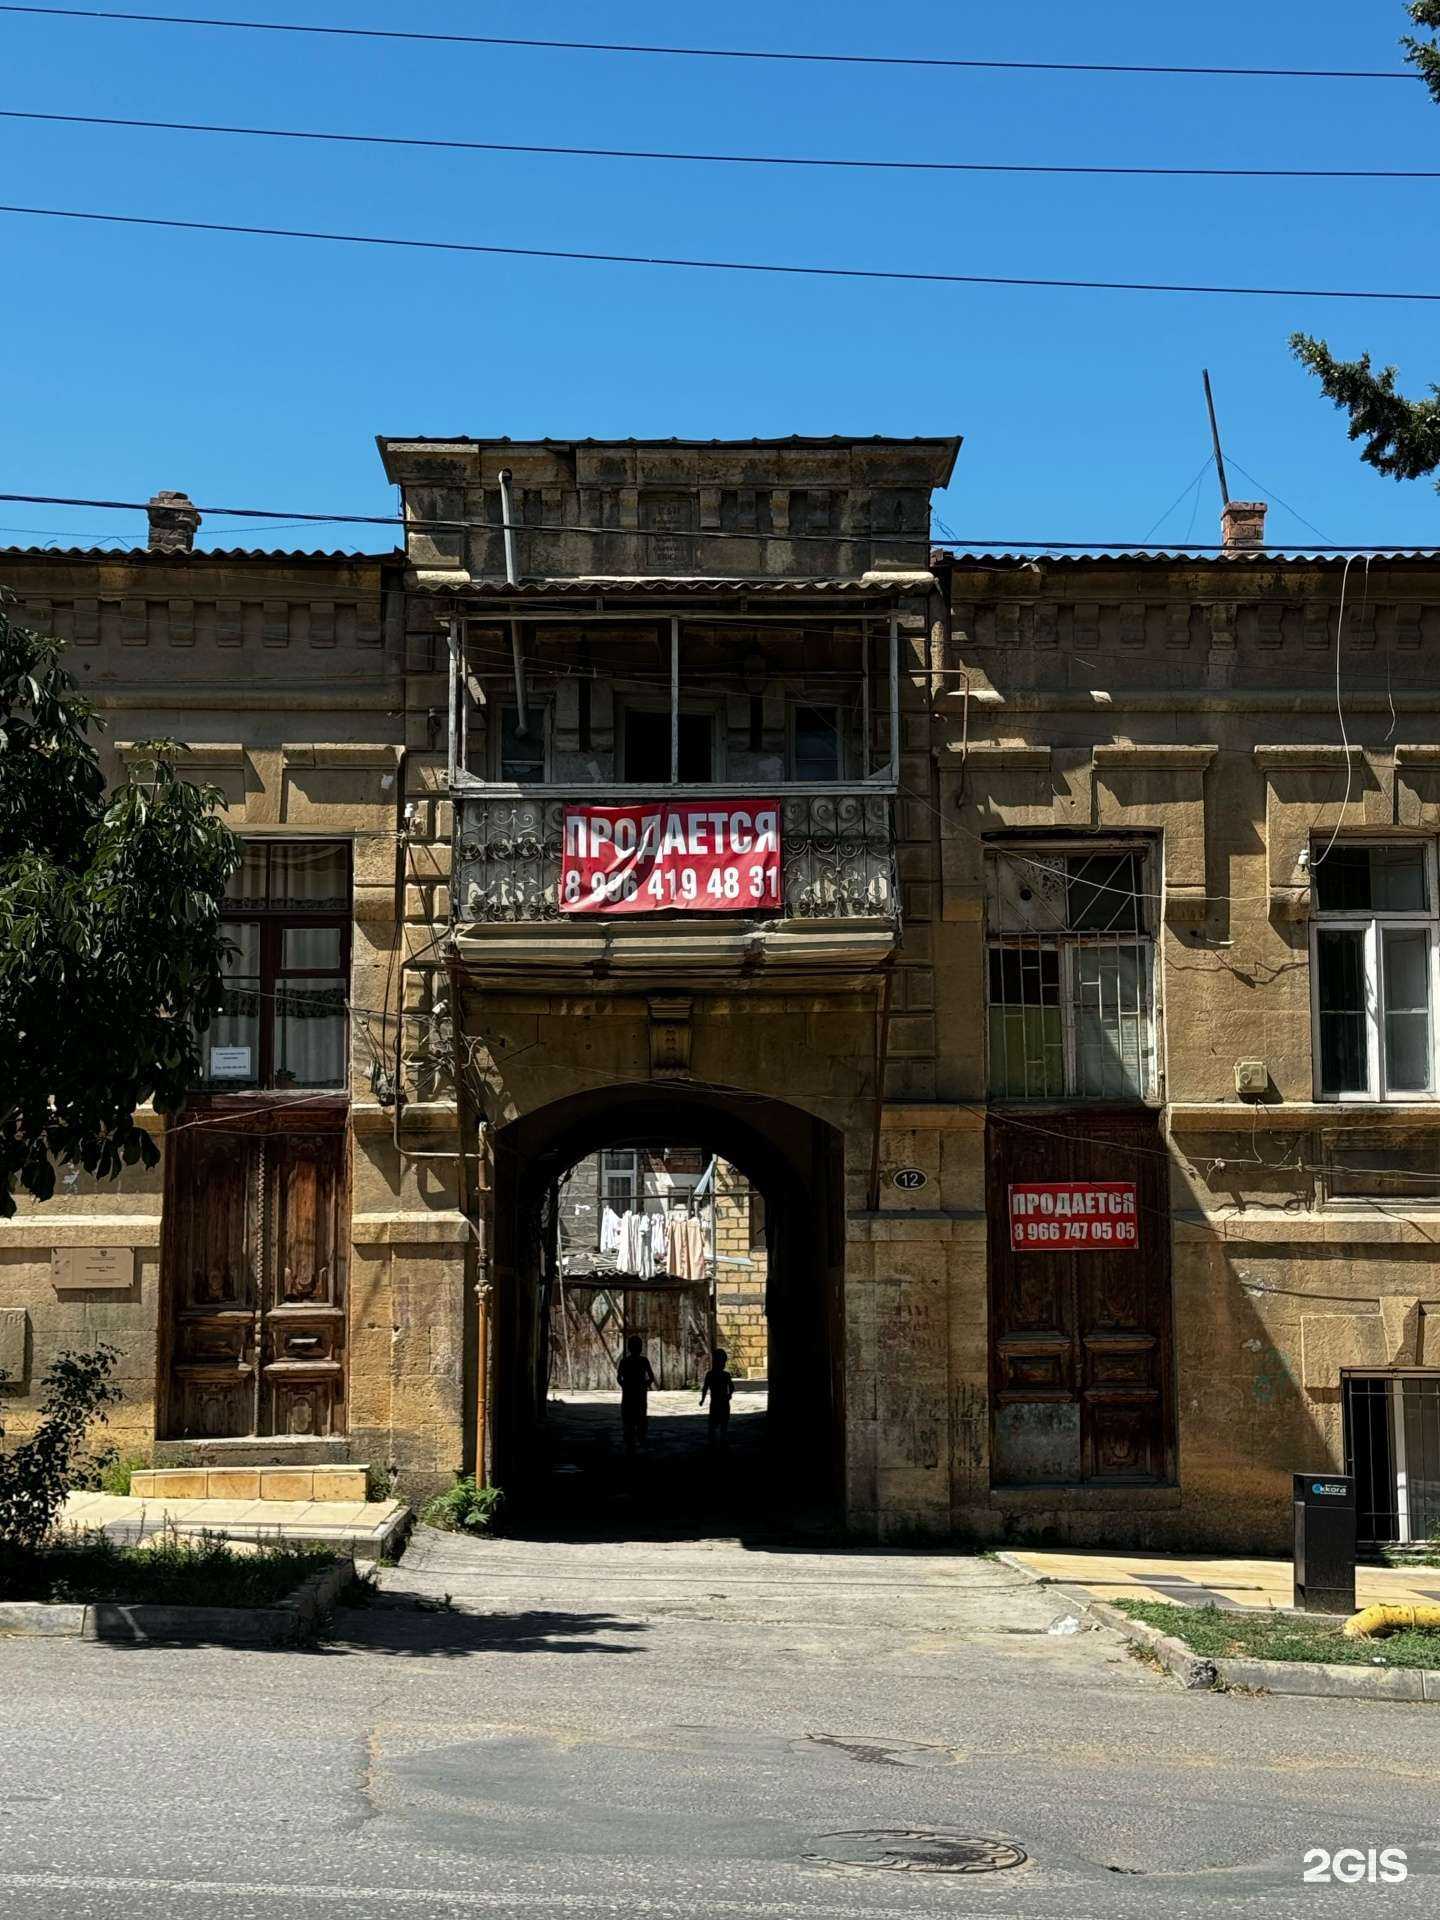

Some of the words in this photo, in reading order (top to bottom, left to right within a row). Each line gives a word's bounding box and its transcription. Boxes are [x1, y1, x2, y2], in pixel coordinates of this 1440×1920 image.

[566, 811, 777, 864] ПРОДАЕТСЯ
[566, 870, 581, 903] 8
[647, 868, 698, 900] 419
[706, 867, 739, 899] 48
[749, 866, 778, 898] 31
[901, 1173, 919, 1187] 12
[1012, 1192, 1135, 1217] ПРОДАЕТСЯ
[1014, 1223, 1024, 1240] 8
[1027, 1222, 1060, 1240] 966
[1062, 1222, 1088, 1240] 747
[1091, 1222, 1113, 1240] 05
[1116, 1222, 1135, 1240] 05
